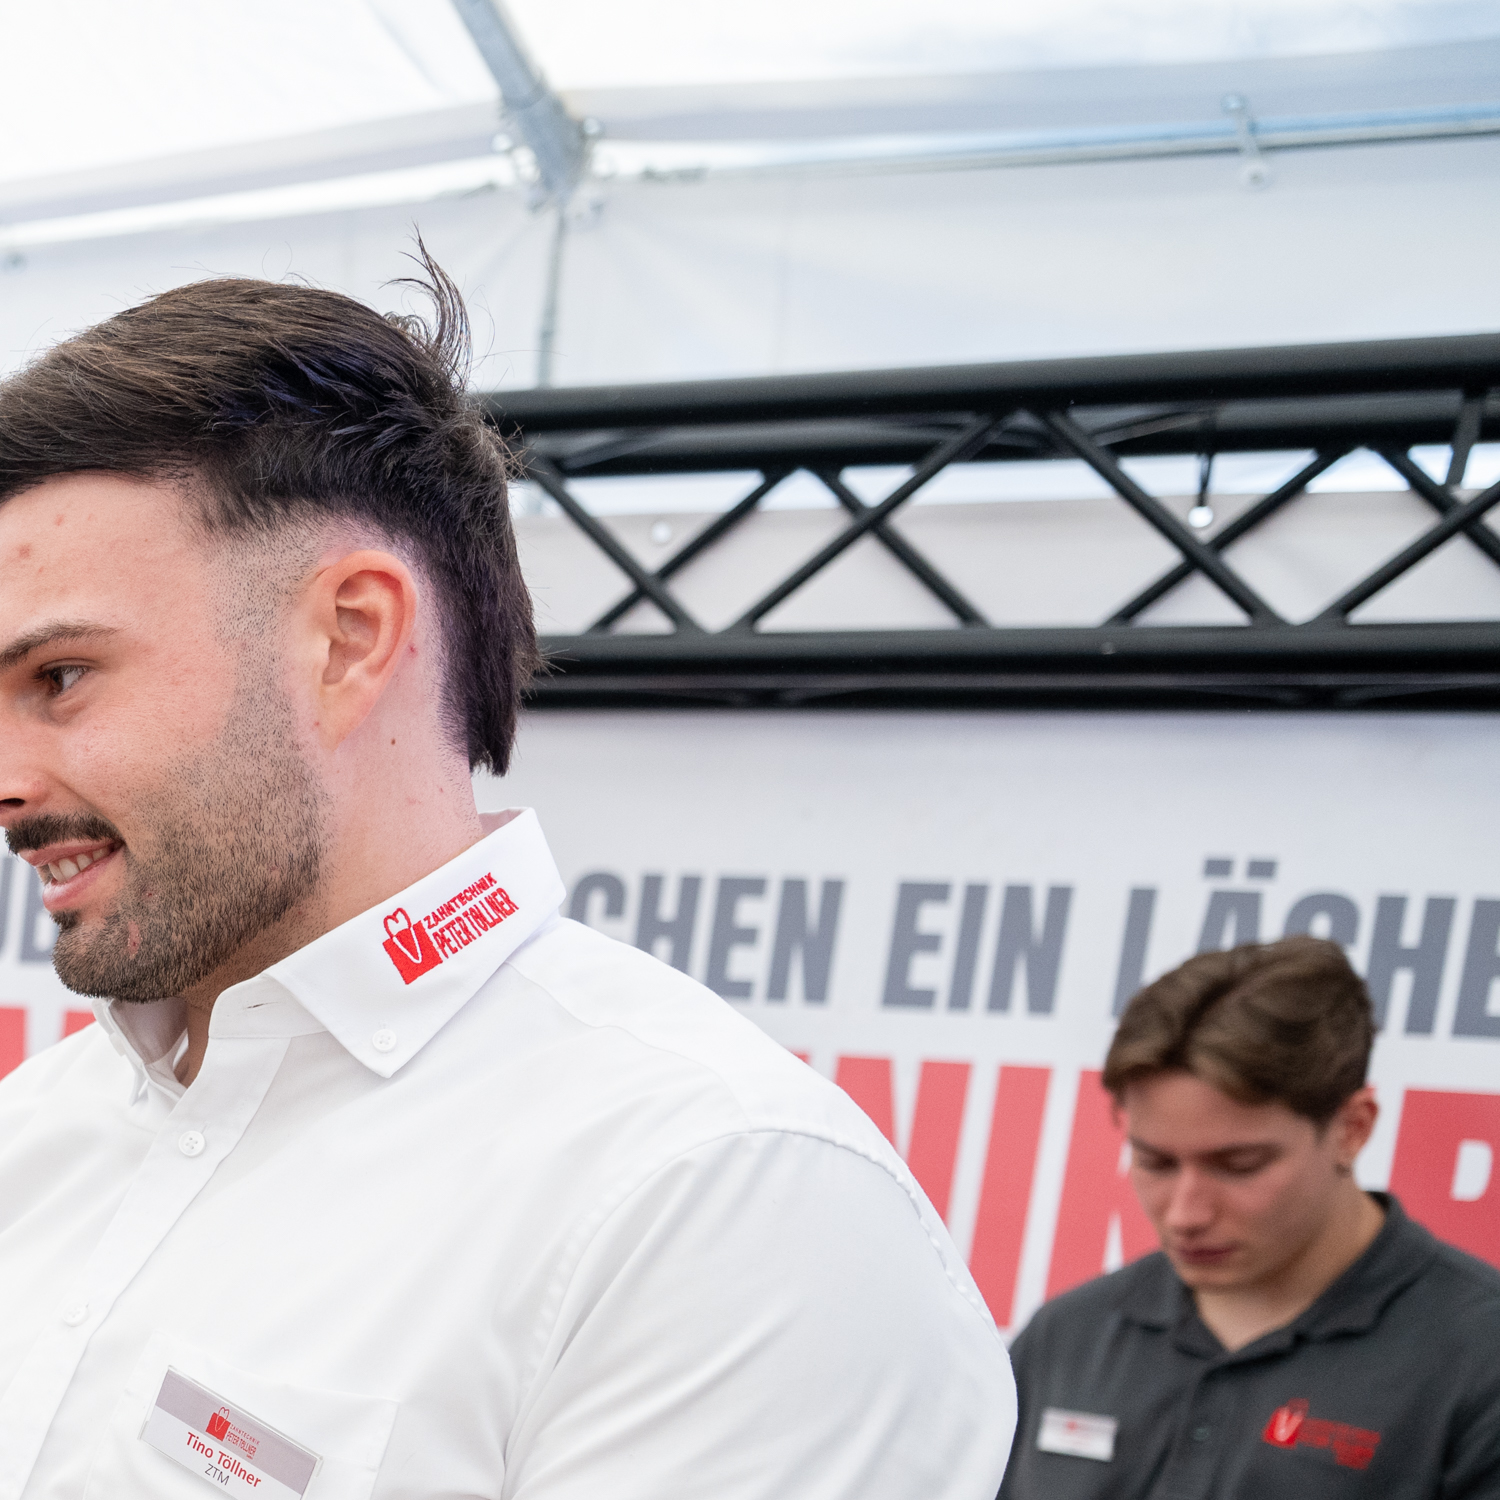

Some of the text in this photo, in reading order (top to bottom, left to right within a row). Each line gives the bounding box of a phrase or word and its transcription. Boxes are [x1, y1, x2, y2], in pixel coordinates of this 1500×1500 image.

[423, 872, 498, 930] ZAHNTECHNIK
[432, 916, 477, 959] PETER
[879, 879, 1075, 1017] EIN
[186, 1431, 261, 1487] Tino Töllner
[204, 1463, 230, 1486] ZTM
